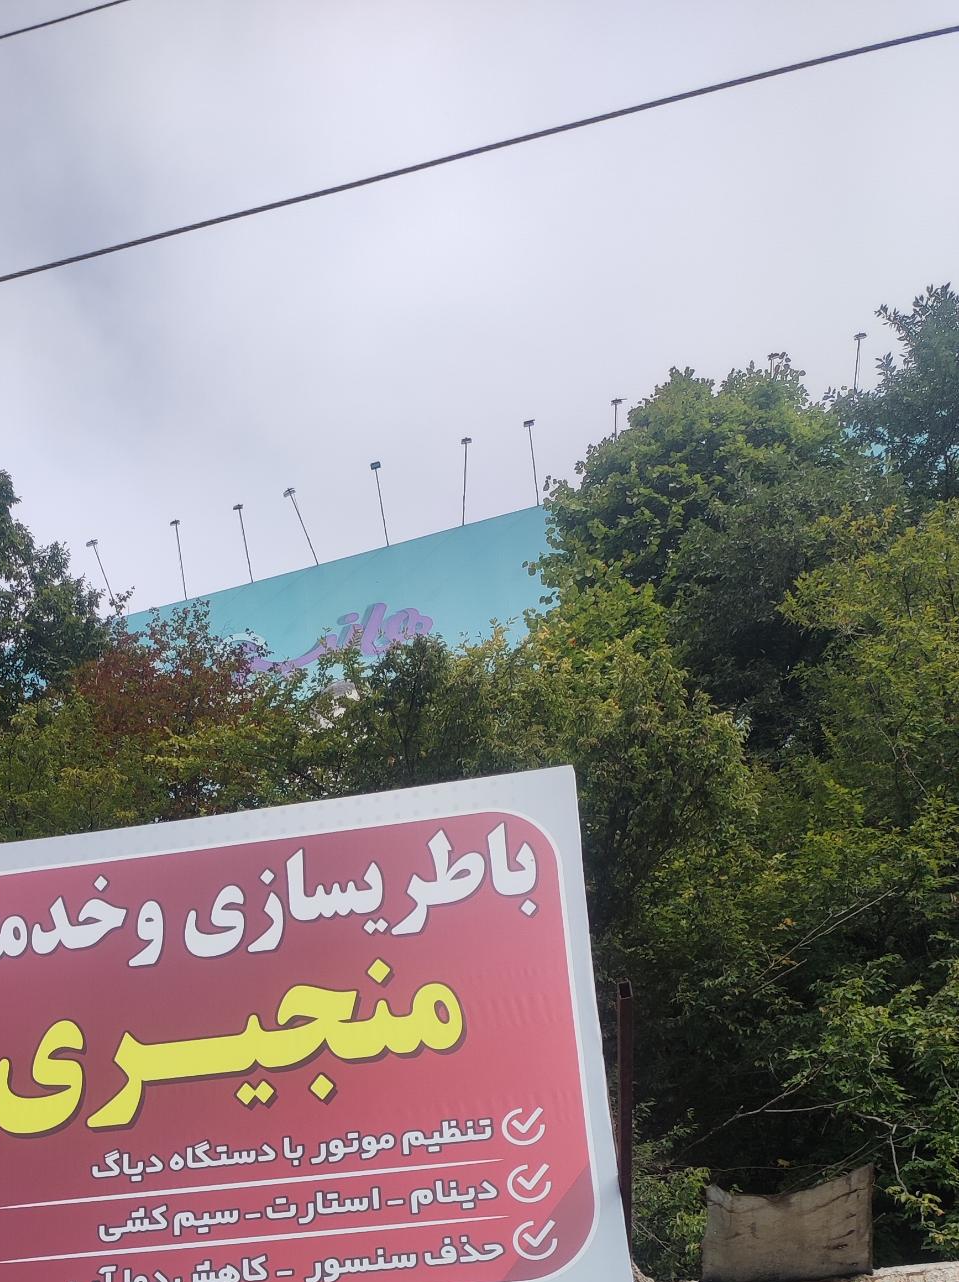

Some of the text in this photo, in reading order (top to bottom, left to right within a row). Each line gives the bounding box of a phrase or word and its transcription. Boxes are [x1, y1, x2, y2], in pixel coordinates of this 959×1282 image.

[90, 1118, 493, 1182] تنظیم موتور با دستگاه دیاگ
[265, 1187, 380, 1225] استارت
[410, 1179, 499, 1214] دینام
[97, 1204, 169, 1242] کشی
[172, 1208, 240, 1237] سیم
[424, 1235, 505, 1267] حذف
